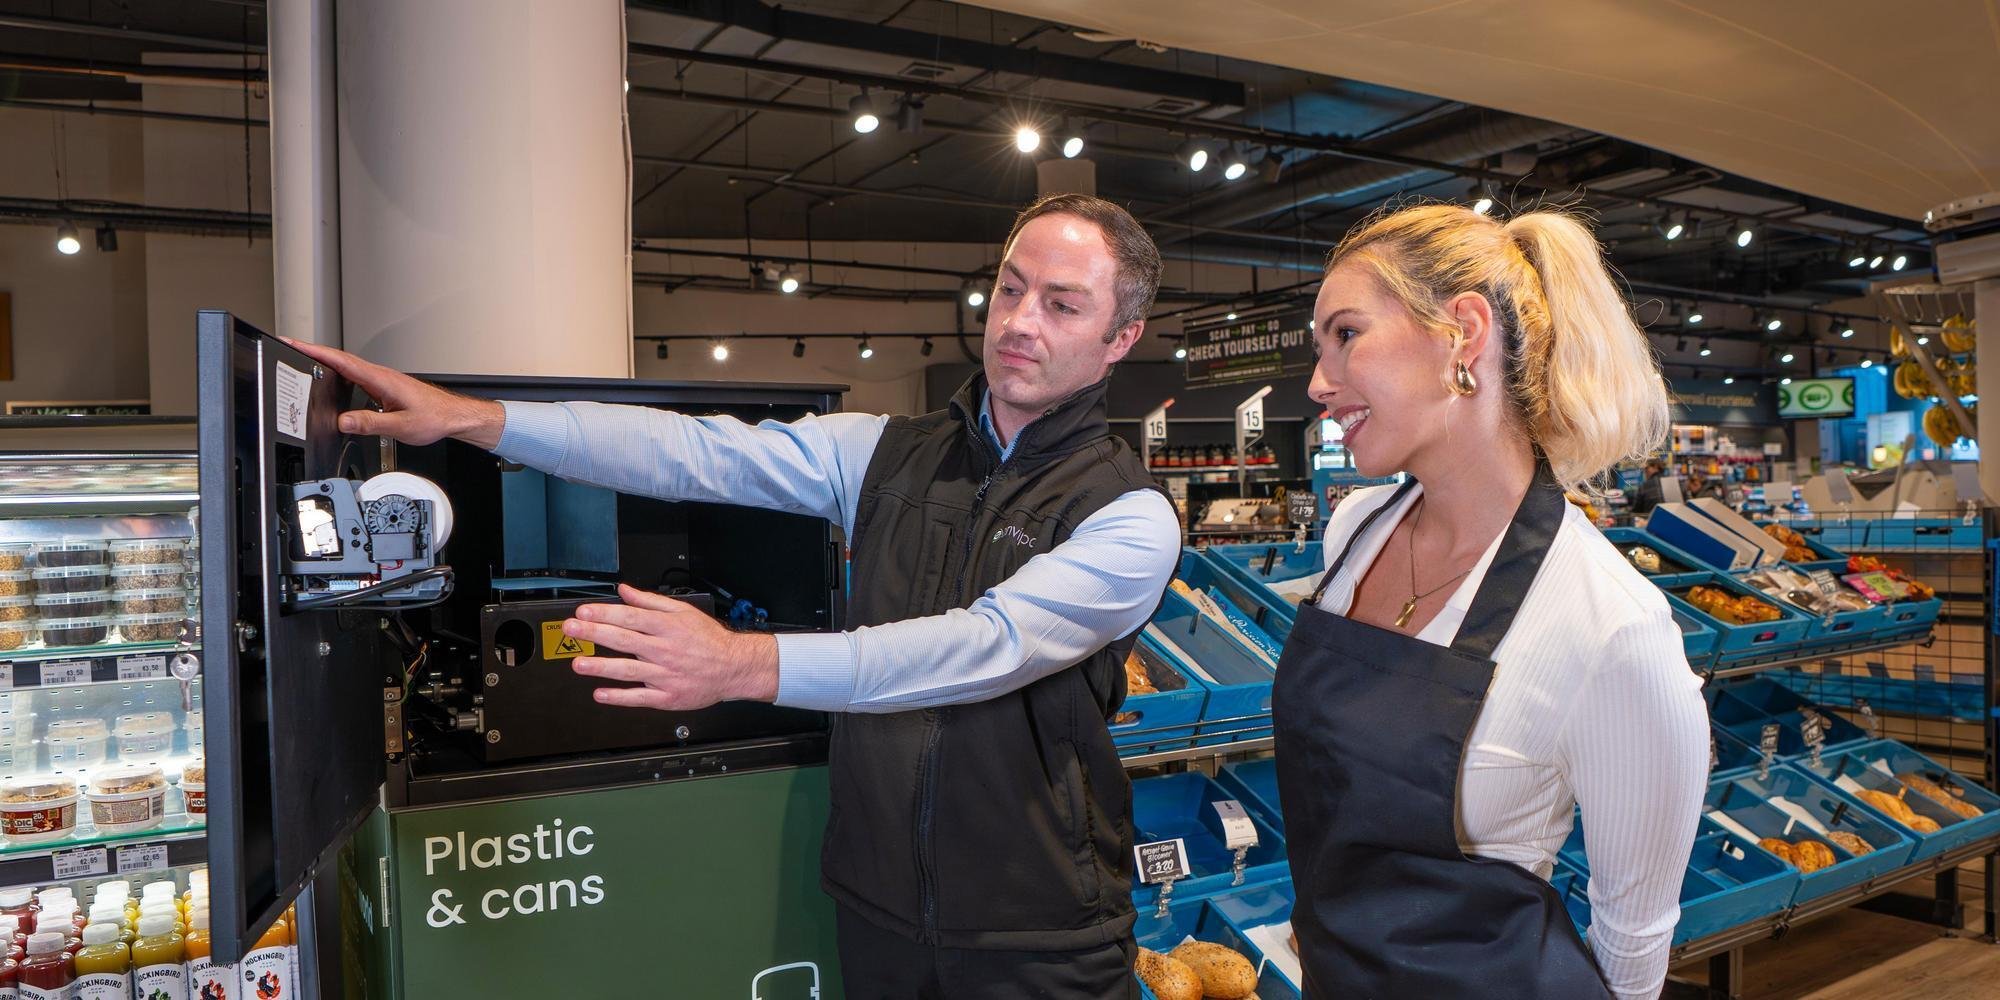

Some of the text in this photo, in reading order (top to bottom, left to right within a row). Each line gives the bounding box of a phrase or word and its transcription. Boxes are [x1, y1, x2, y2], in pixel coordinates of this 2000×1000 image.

[1209, 320, 1279, 341] SCAN PAY GO
[1188, 341, 1222, 362] CHECK
[1223, 333, 1279, 356] YOURSELF
[1281, 329, 1305, 348] OUT
[1150, 421, 1163, 436] 16
[1245, 411, 1260, 427] 15
[425, 818, 594, 875] Plastic
[426, 875, 605, 928] & cans
[245, 952, 285, 967] MOCKINGBIRD
